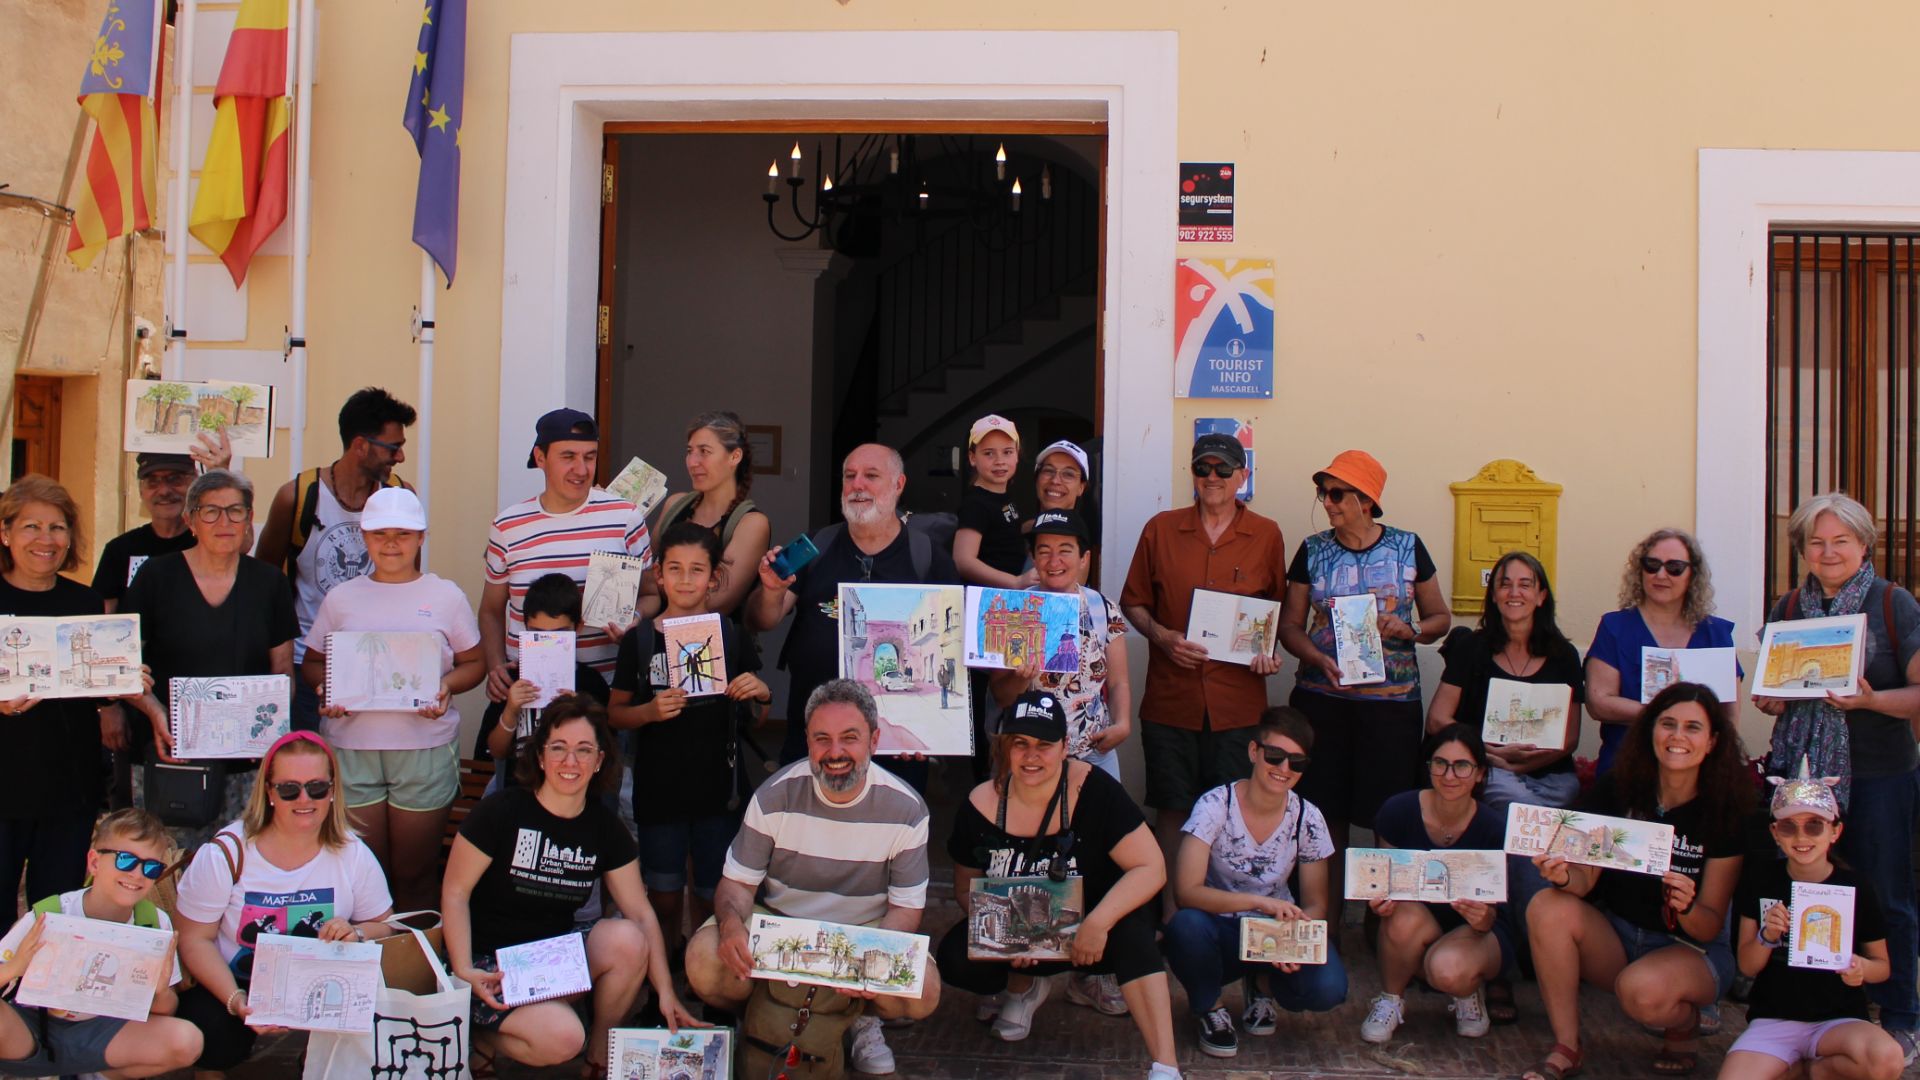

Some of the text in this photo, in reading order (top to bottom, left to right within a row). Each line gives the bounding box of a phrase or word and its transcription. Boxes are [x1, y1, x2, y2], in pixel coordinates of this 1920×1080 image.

[1180, 193, 1233, 206] segursystem
[1179, 230, 1233, 240] 902 922 555
[1208, 359, 1264, 371] TOURIST
[1220, 371, 1251, 383] INFO
[1211, 385, 1260, 393] MASCARELL
[1516, 806, 1552, 826] MAS
[1520, 823, 1541, 837] CA
[1511, 835, 1545, 852] RELL
[540, 857, 594, 871] Urban Sketchers
